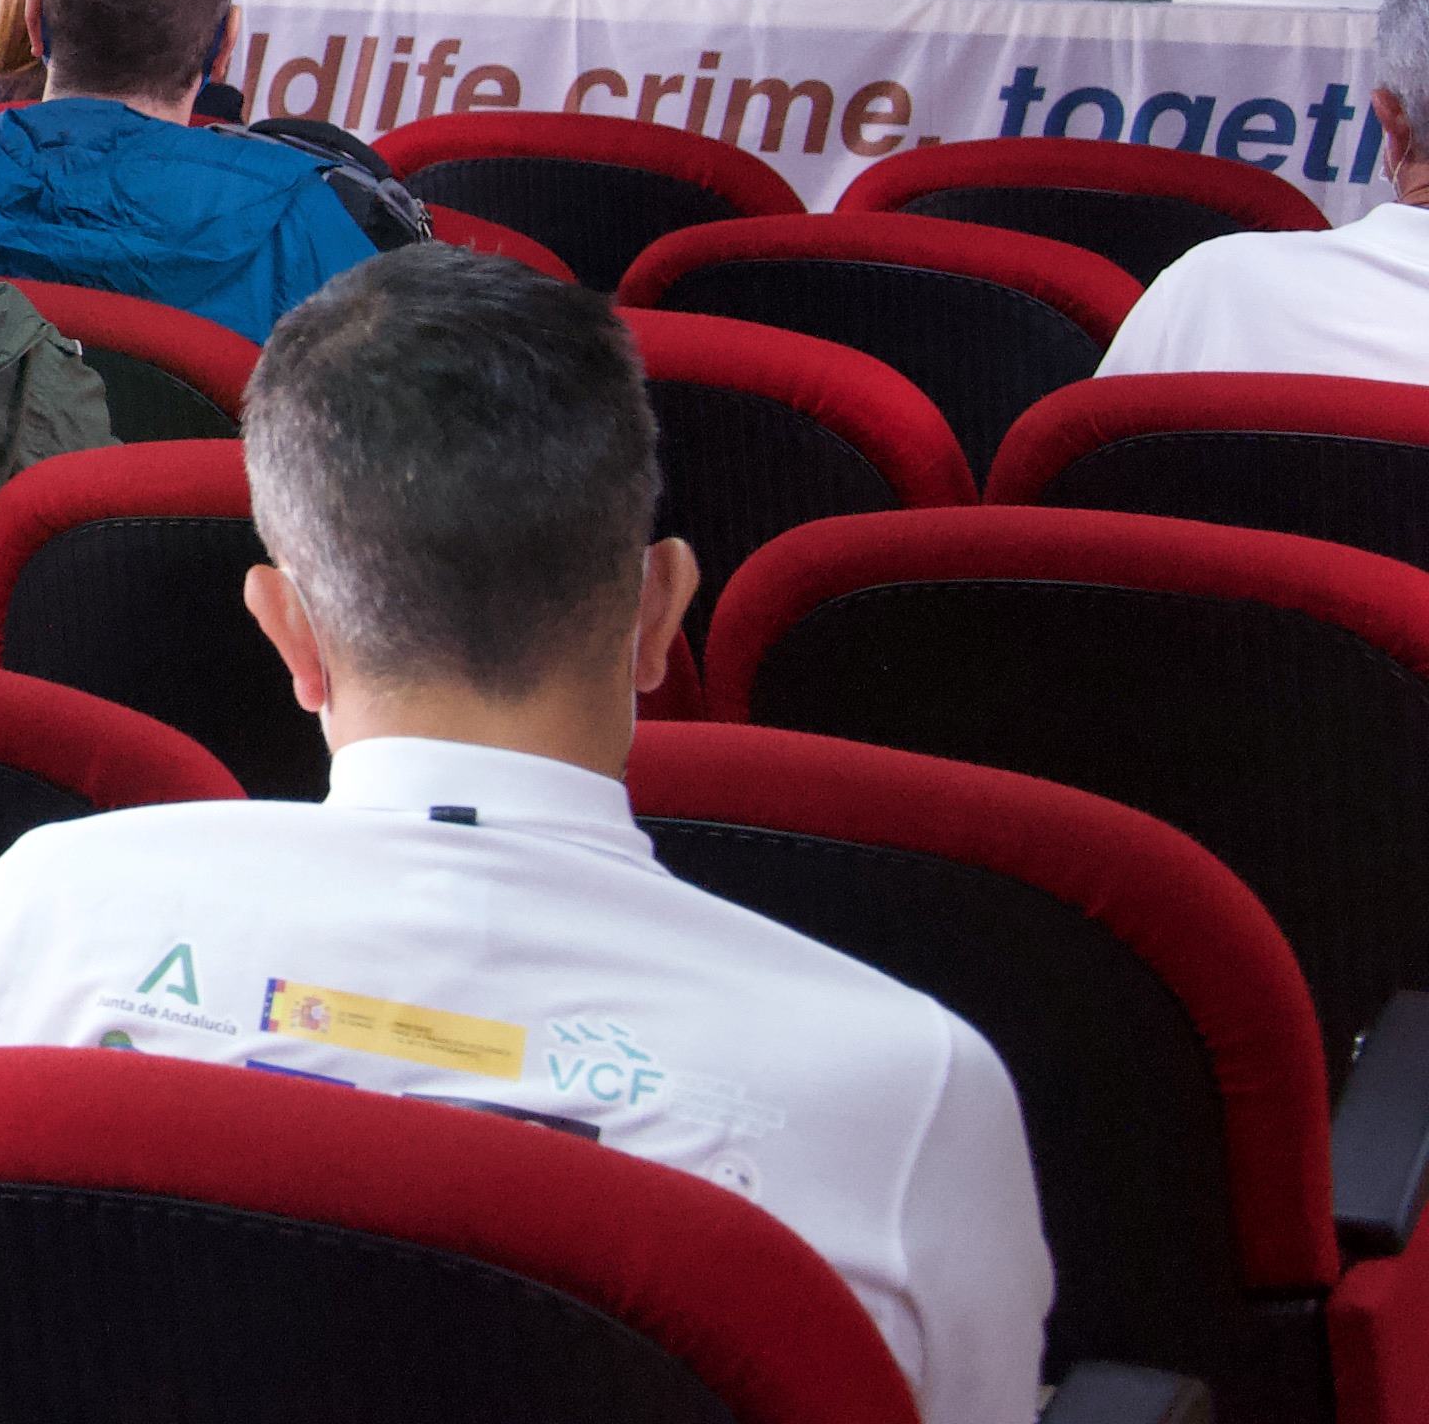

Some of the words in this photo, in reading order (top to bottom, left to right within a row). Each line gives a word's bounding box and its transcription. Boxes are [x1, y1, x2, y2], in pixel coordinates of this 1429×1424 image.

[241, 32, 522, 131] ldlife
[998, 66, 1384, 184] toget
[138, 1002, 158, 1018] de
[548, 1053, 666, 1105] VCF
